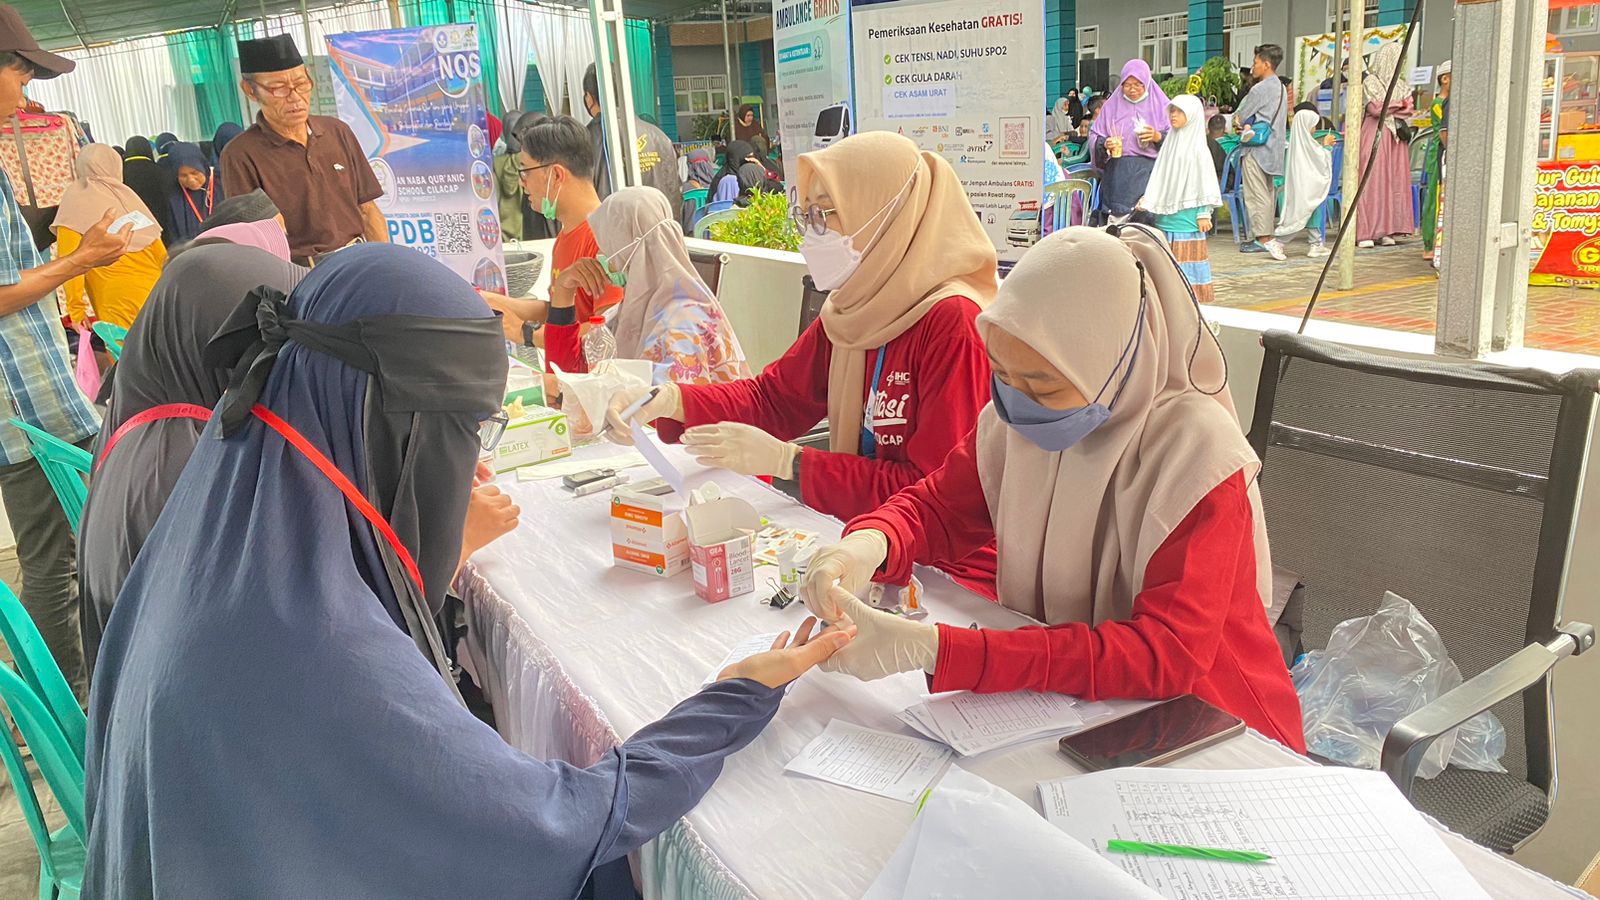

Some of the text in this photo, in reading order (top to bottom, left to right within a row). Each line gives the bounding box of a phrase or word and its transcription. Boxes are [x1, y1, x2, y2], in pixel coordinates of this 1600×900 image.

[776, 0, 840, 30] AMBULANCE GRATIS
[868, 13, 1023, 39] Pemeriksaan Kesehatan GRATIS!
[894, 46, 1007, 63] CEK TENSI, NADI, SUHU SPO2
[895, 71, 962, 83] CEK GULA DARAH
[894, 88, 947, 98] CEK ASAM URAT
[396, 173, 465, 185] AN NABA QUR'ANIC
[398, 184, 459, 195] SCHOOL CILACAP
[1532, 212, 1547, 229] &
[387, 219, 435, 244] PDB
[894, 371, 910, 381] IHC
[508, 441, 529, 453] LATEX
[729, 551, 747, 559] Blood
[729, 556, 750, 565] Lancet
